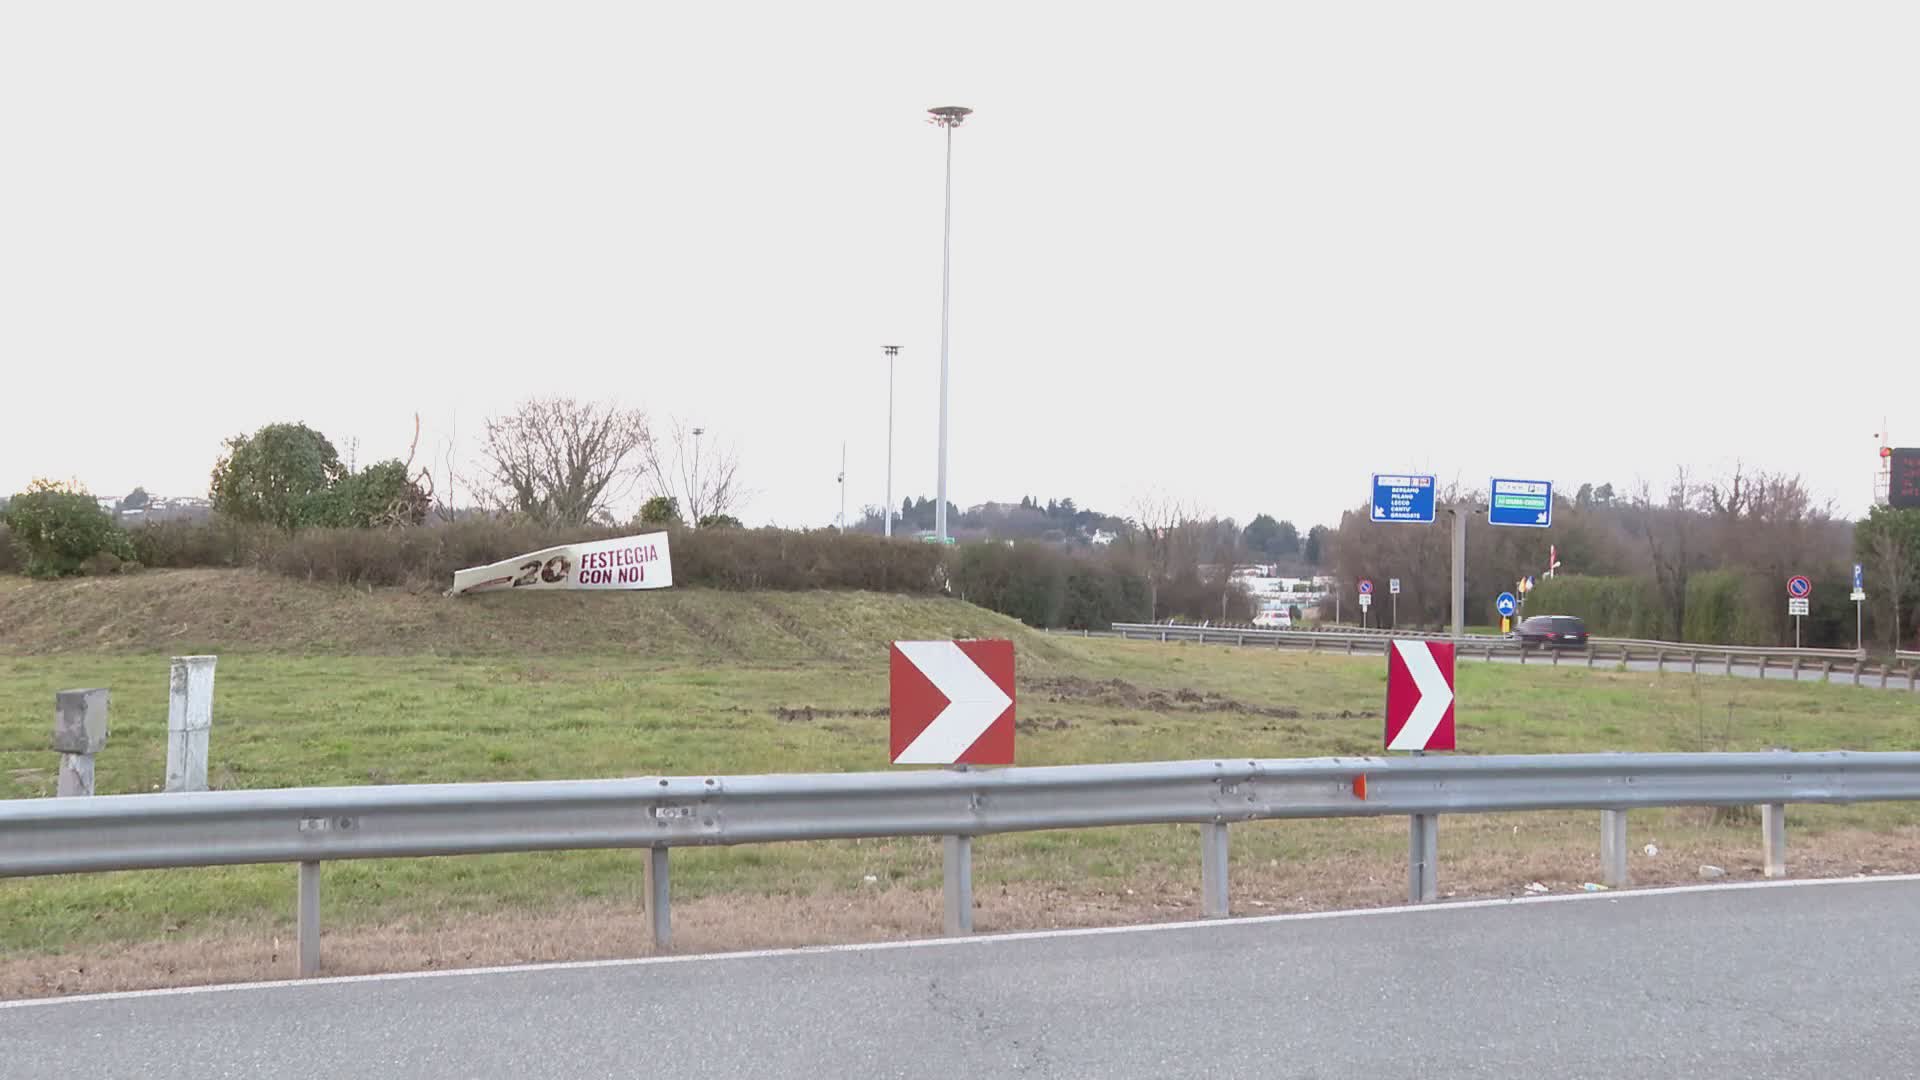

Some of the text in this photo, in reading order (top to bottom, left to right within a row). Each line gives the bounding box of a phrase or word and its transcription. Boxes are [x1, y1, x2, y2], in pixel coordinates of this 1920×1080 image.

[580, 544, 658, 569] FESTEGGIA
[579, 566, 644, 584] CON NOI
